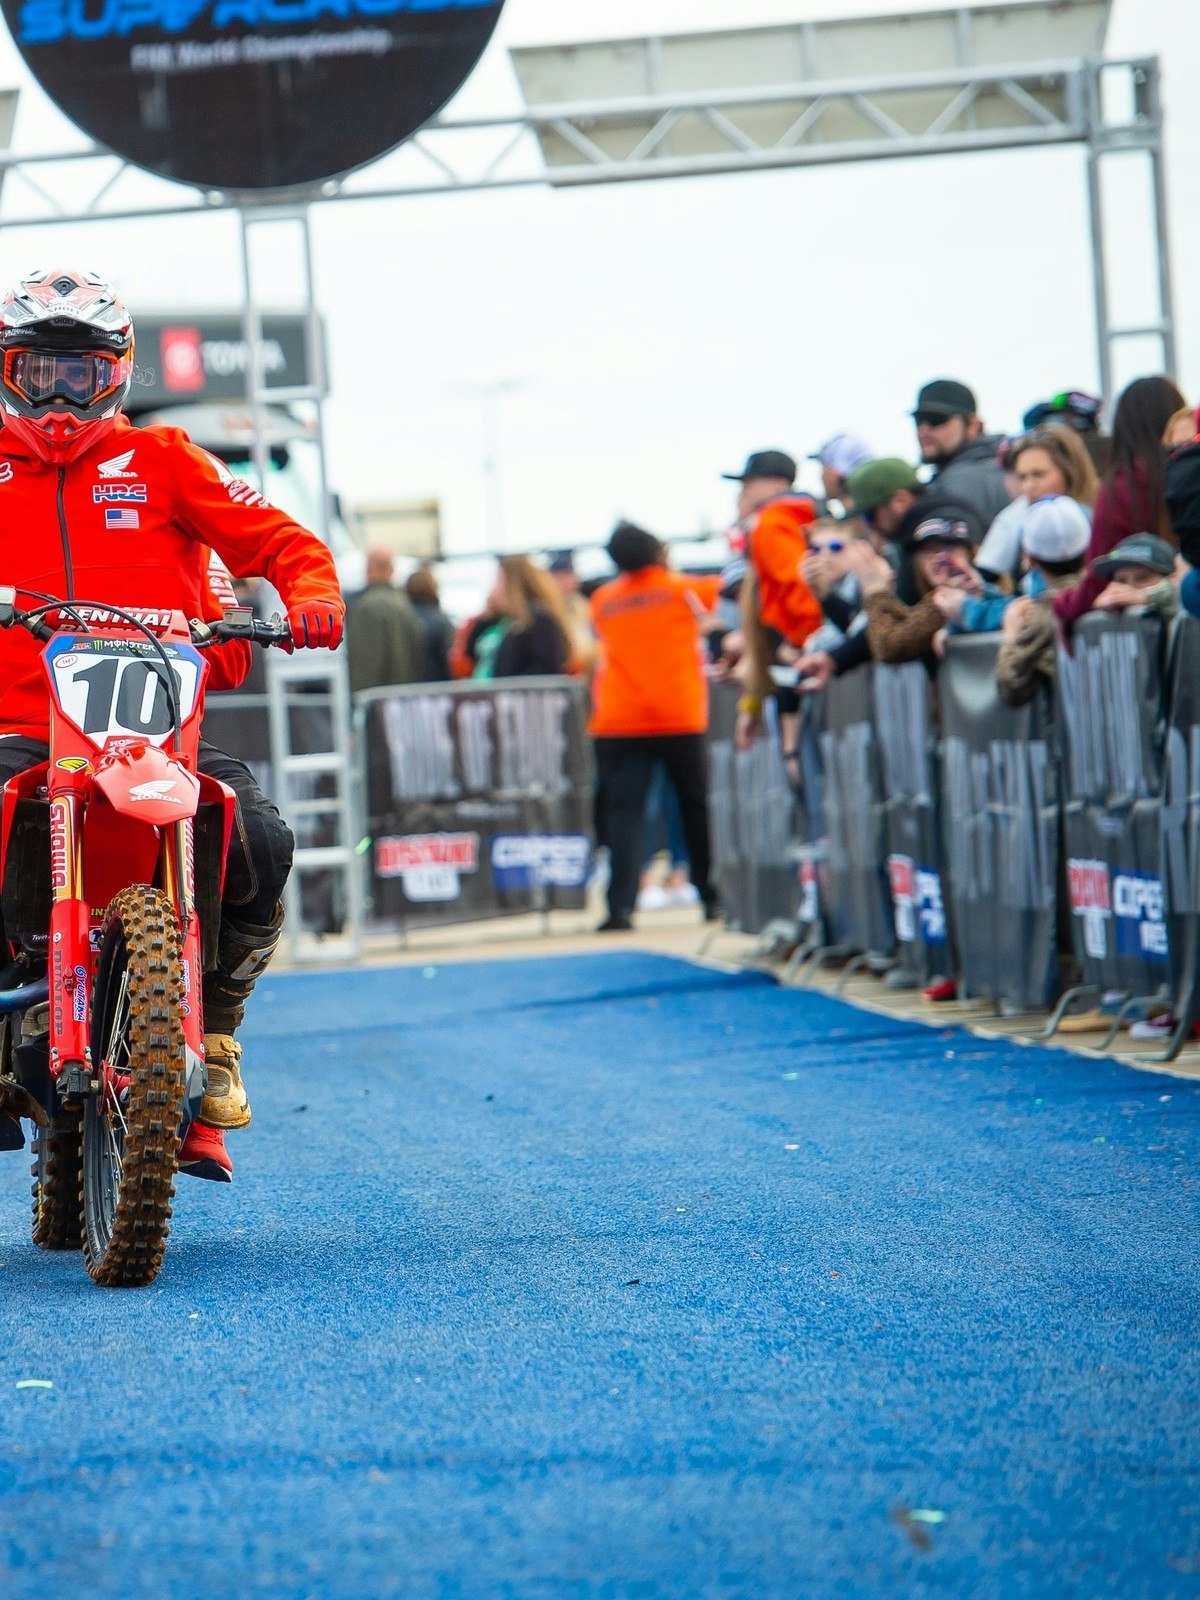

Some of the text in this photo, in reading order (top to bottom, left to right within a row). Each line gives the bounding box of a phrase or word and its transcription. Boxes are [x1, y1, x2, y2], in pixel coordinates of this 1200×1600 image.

[99, 471, 138, 479] HONDA
[93, 484, 147, 503] HRC
[104, 639, 157, 652] MONSTER
[73, 659, 182, 736] 10
[130, 792, 184, 805] HONDA
[50, 803, 67, 890] SHOWA
[54, 950, 63, 1035] DUNLOP
